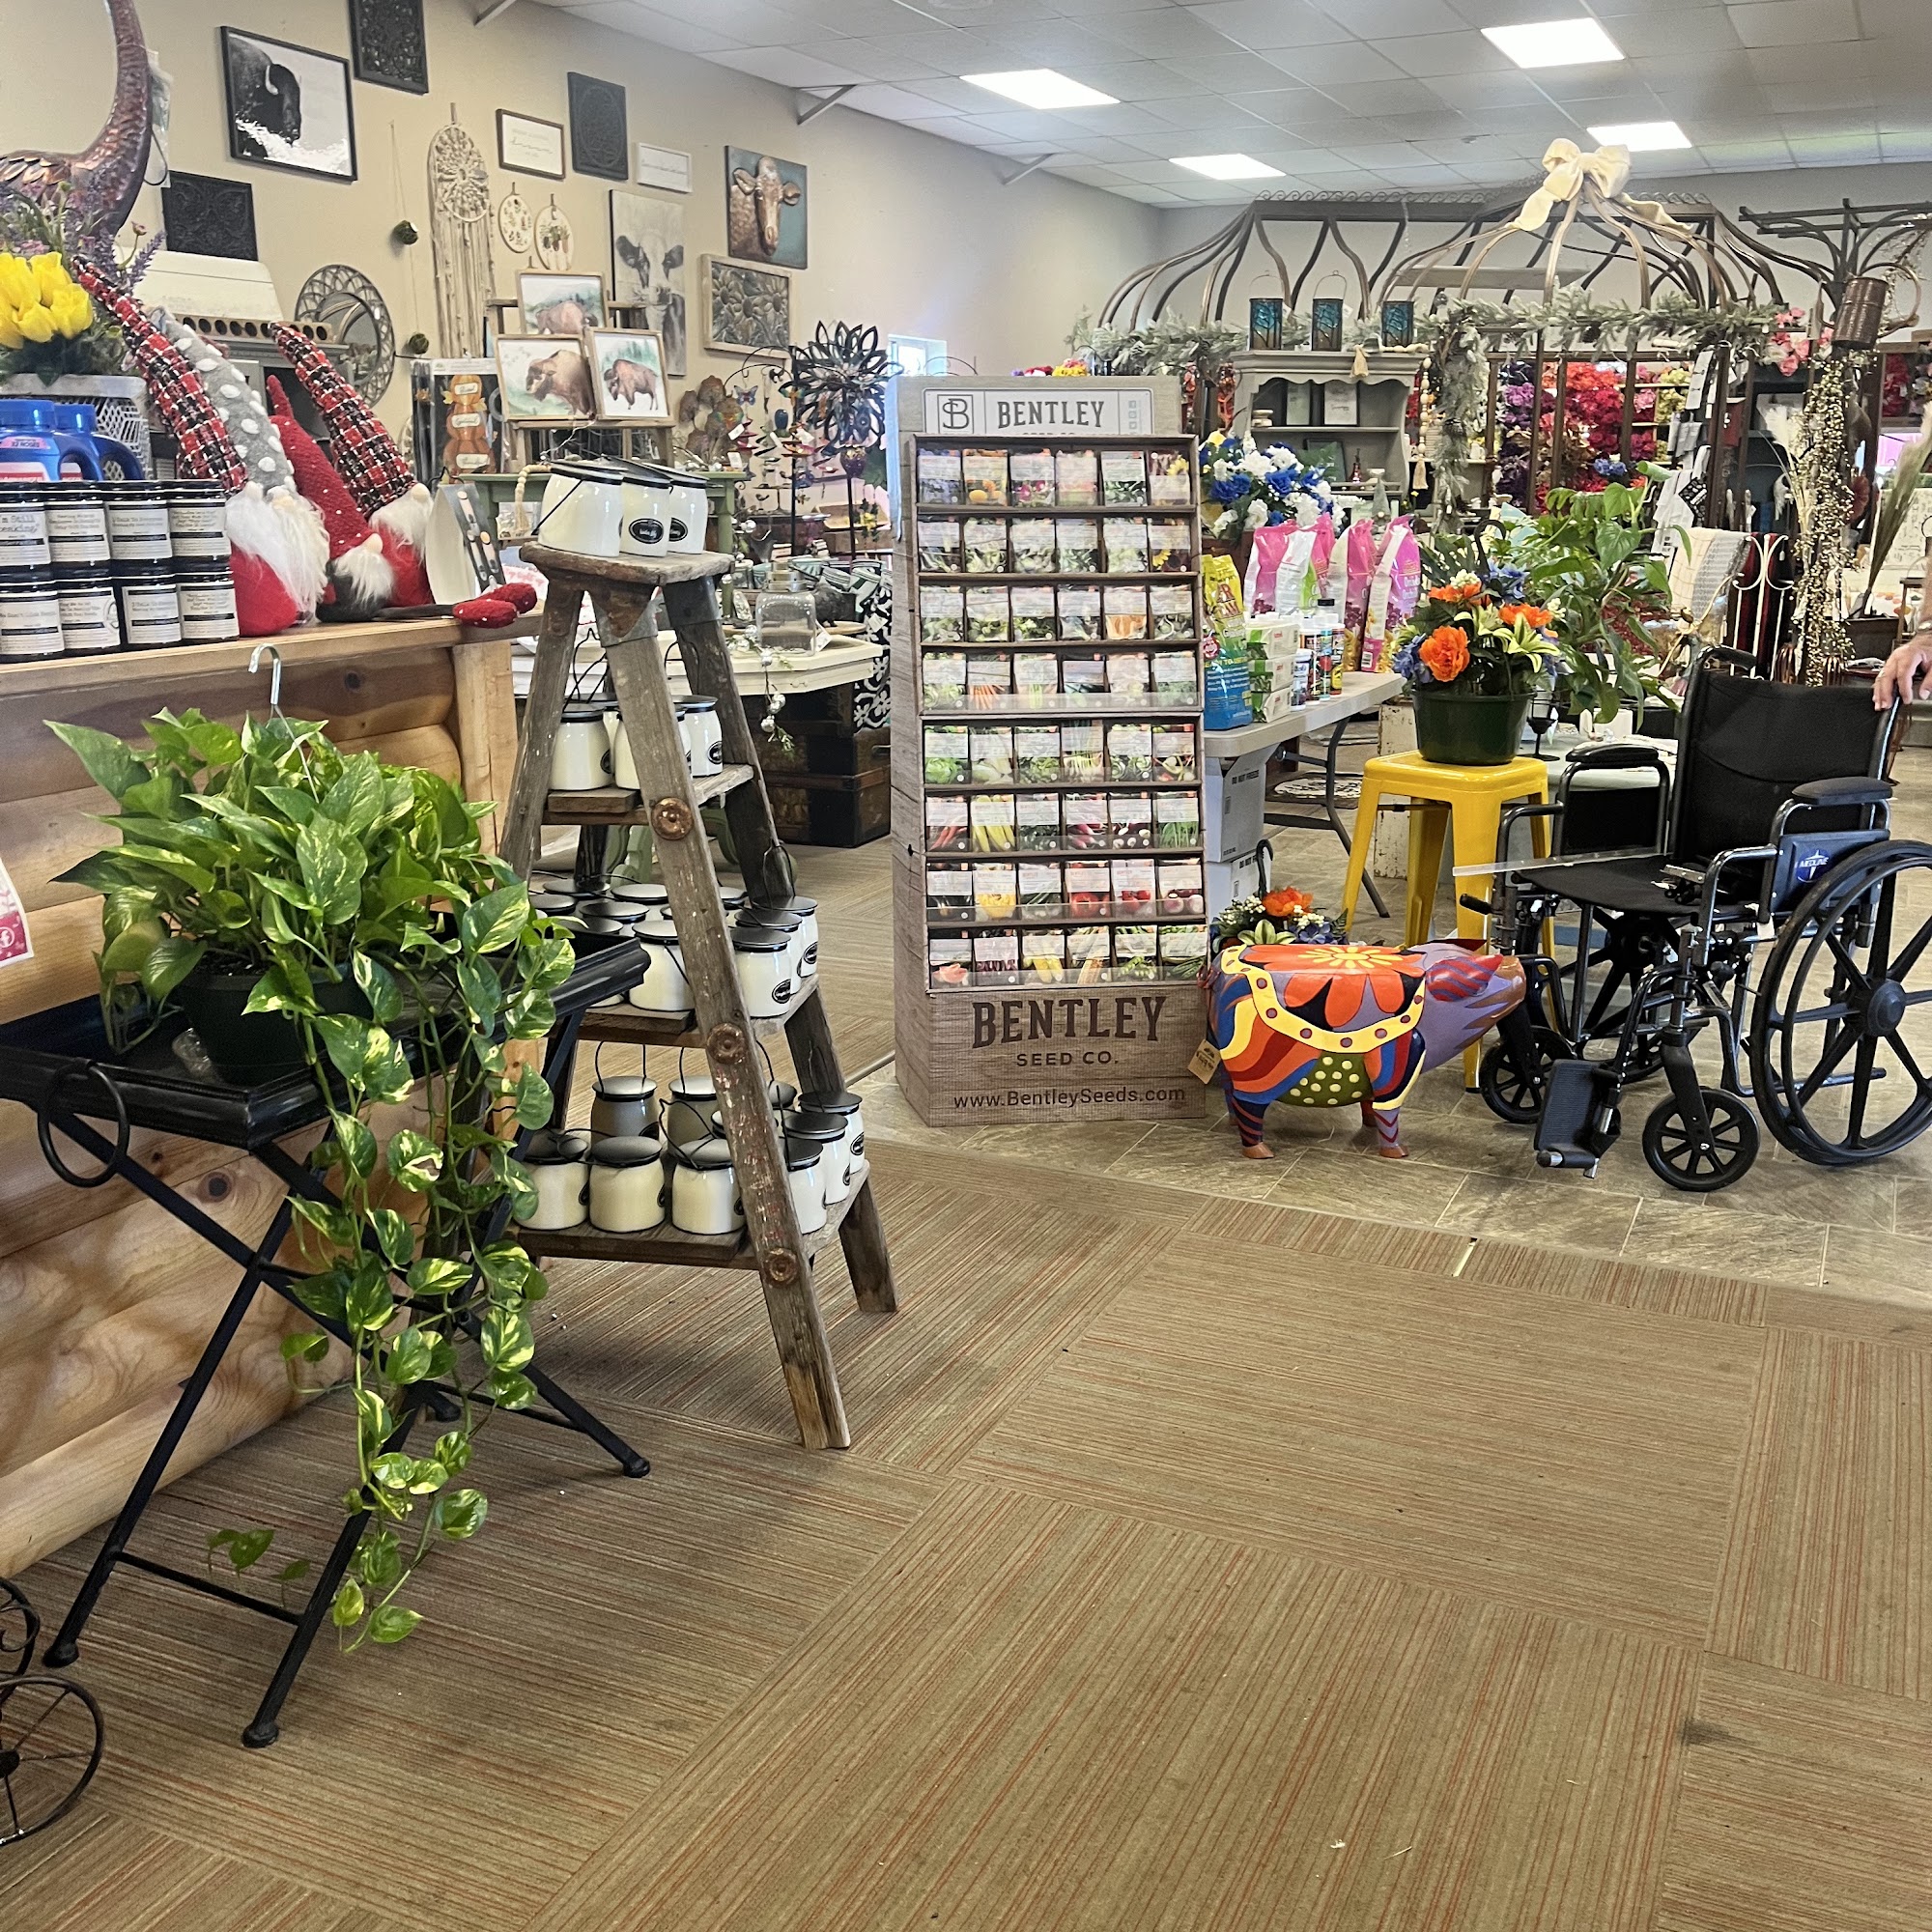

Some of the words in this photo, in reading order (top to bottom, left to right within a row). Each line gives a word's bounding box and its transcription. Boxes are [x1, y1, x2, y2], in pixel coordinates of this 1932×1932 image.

[997, 401, 1104, 429] BENTLEY
[972, 996, 1167, 1049] BENTLEY
[1016, 1052, 1072, 1066] SEED
[1082, 1051, 1119, 1065] CO.
[953, 1087, 1185, 1108] www.BentleySeeds.com
